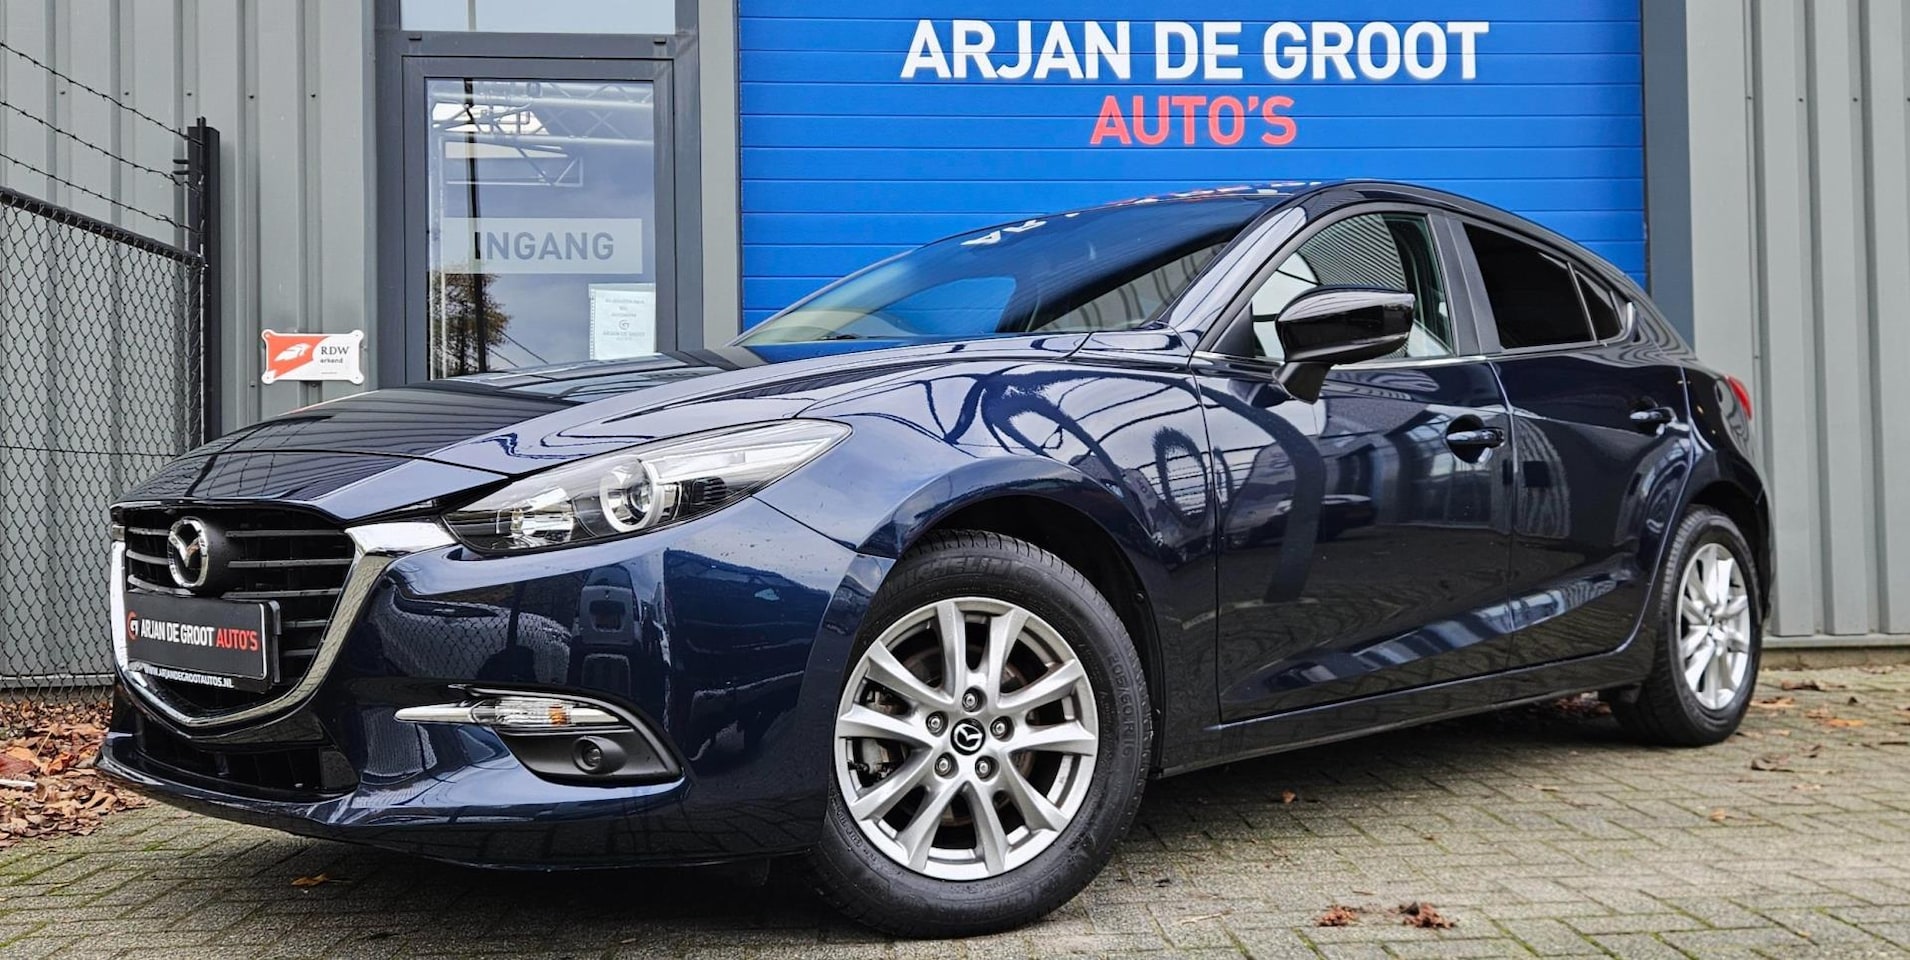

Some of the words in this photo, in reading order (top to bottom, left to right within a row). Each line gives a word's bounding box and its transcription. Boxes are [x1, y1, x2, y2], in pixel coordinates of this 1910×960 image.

[900, 19, 1131, 79] ARJAN
[1155, 21, 1243, 80] DE
[1263, 21, 1490, 80] GROOT
[1090, 95, 1298, 145] AUTO'S
[474, 231, 614, 261] INGANG
[321, 345, 350, 355] RDW
[141, 618, 165, 641] ARJAN
[167, 622, 180, 643] DE
[181, 624, 215, 647] GROOT
[216, 628, 258, 651] AUTO'S
